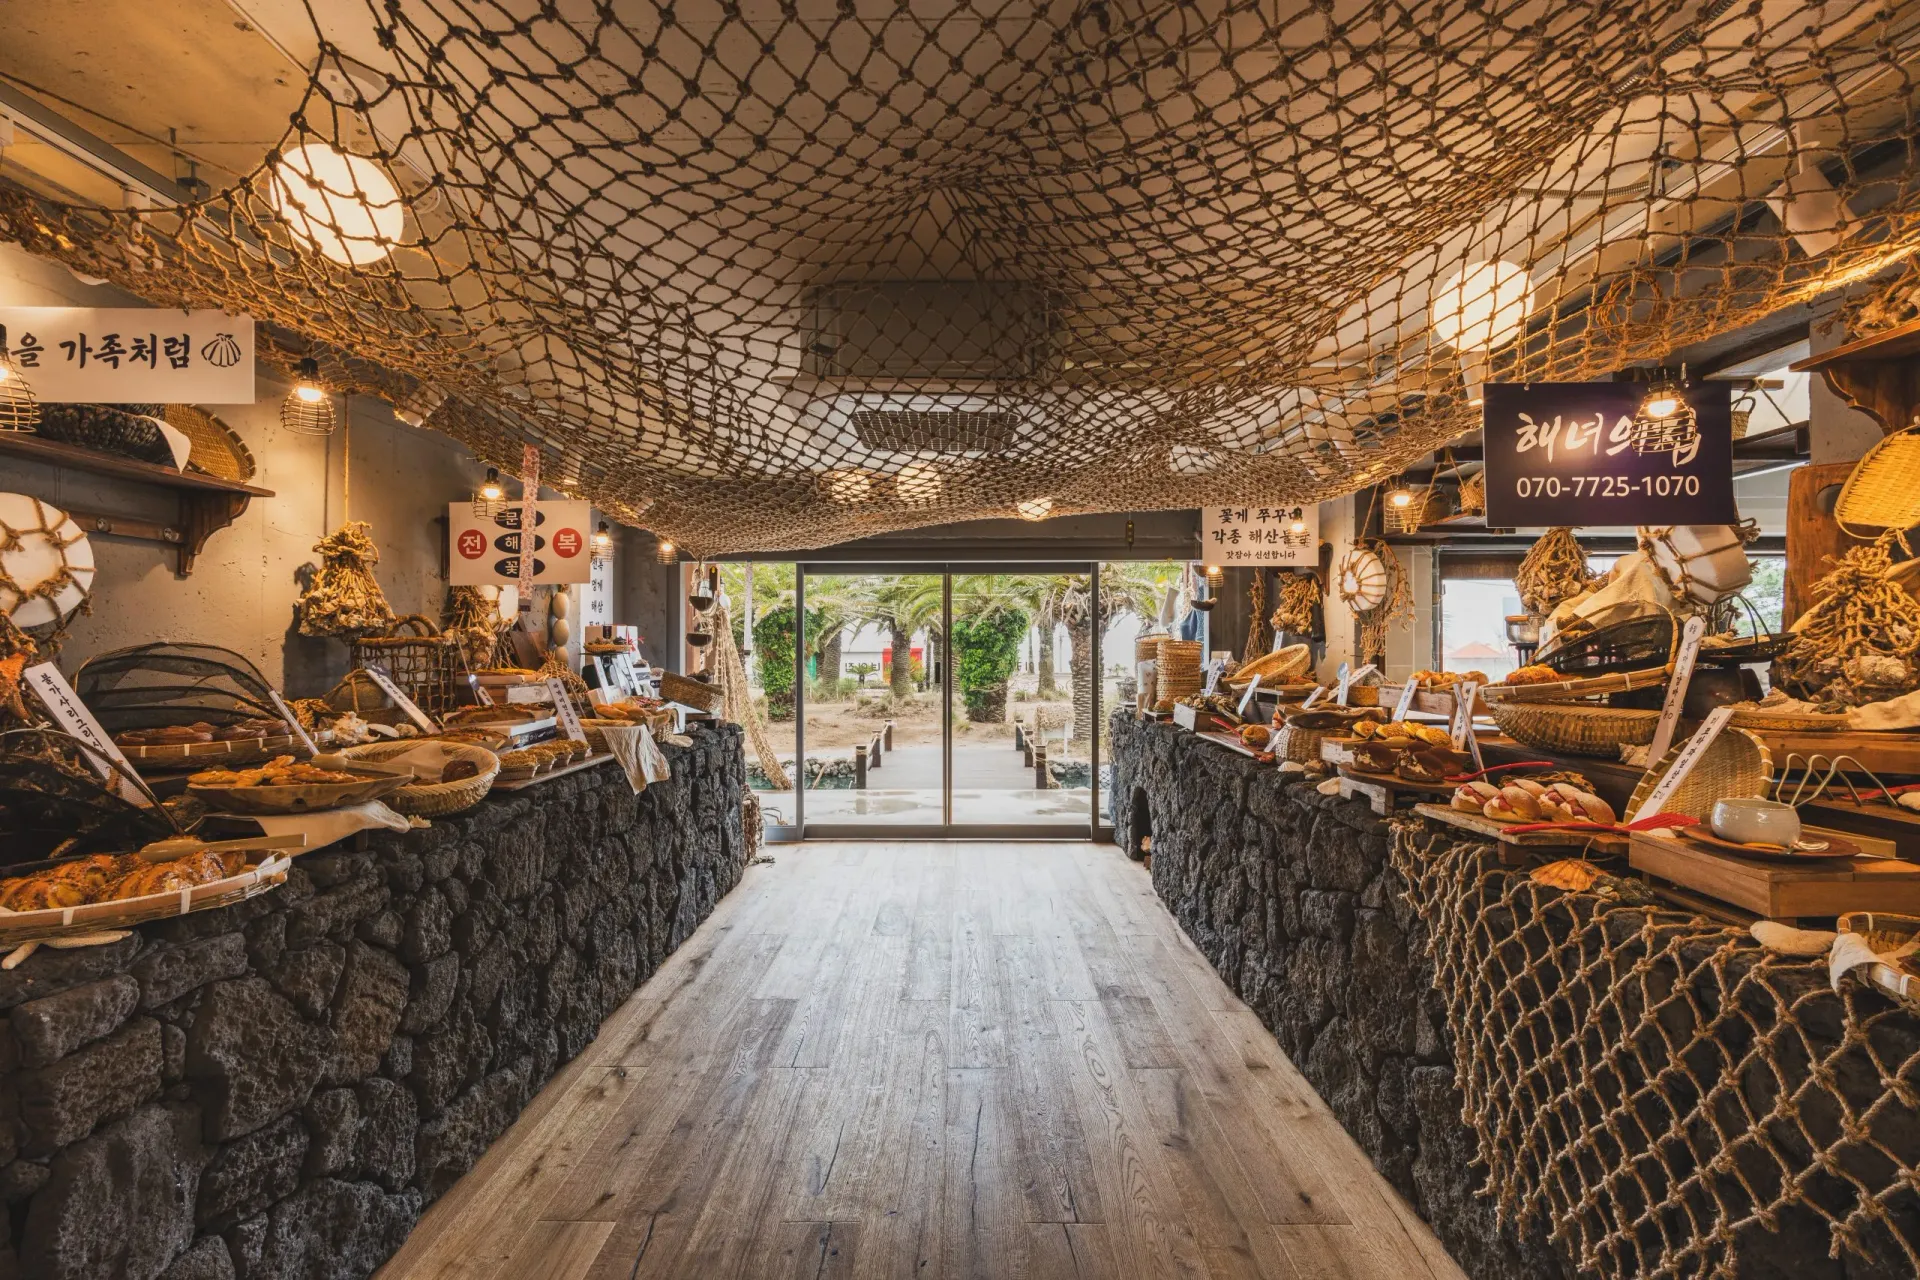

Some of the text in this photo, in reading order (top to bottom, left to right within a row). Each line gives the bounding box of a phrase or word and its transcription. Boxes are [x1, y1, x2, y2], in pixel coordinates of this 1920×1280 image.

[59, 332, 191, 370] 가족처럼
[1516, 475, 1700, 498] 070-7725-1070
[1218, 507, 1300, 524] 꽃게 쭈꾸
[1211, 528, 1242, 545] 각종
[1225, 550, 1297, 560] 갓잡아 신선합니다
[40, 672, 108, 754] 불가사리그리시
